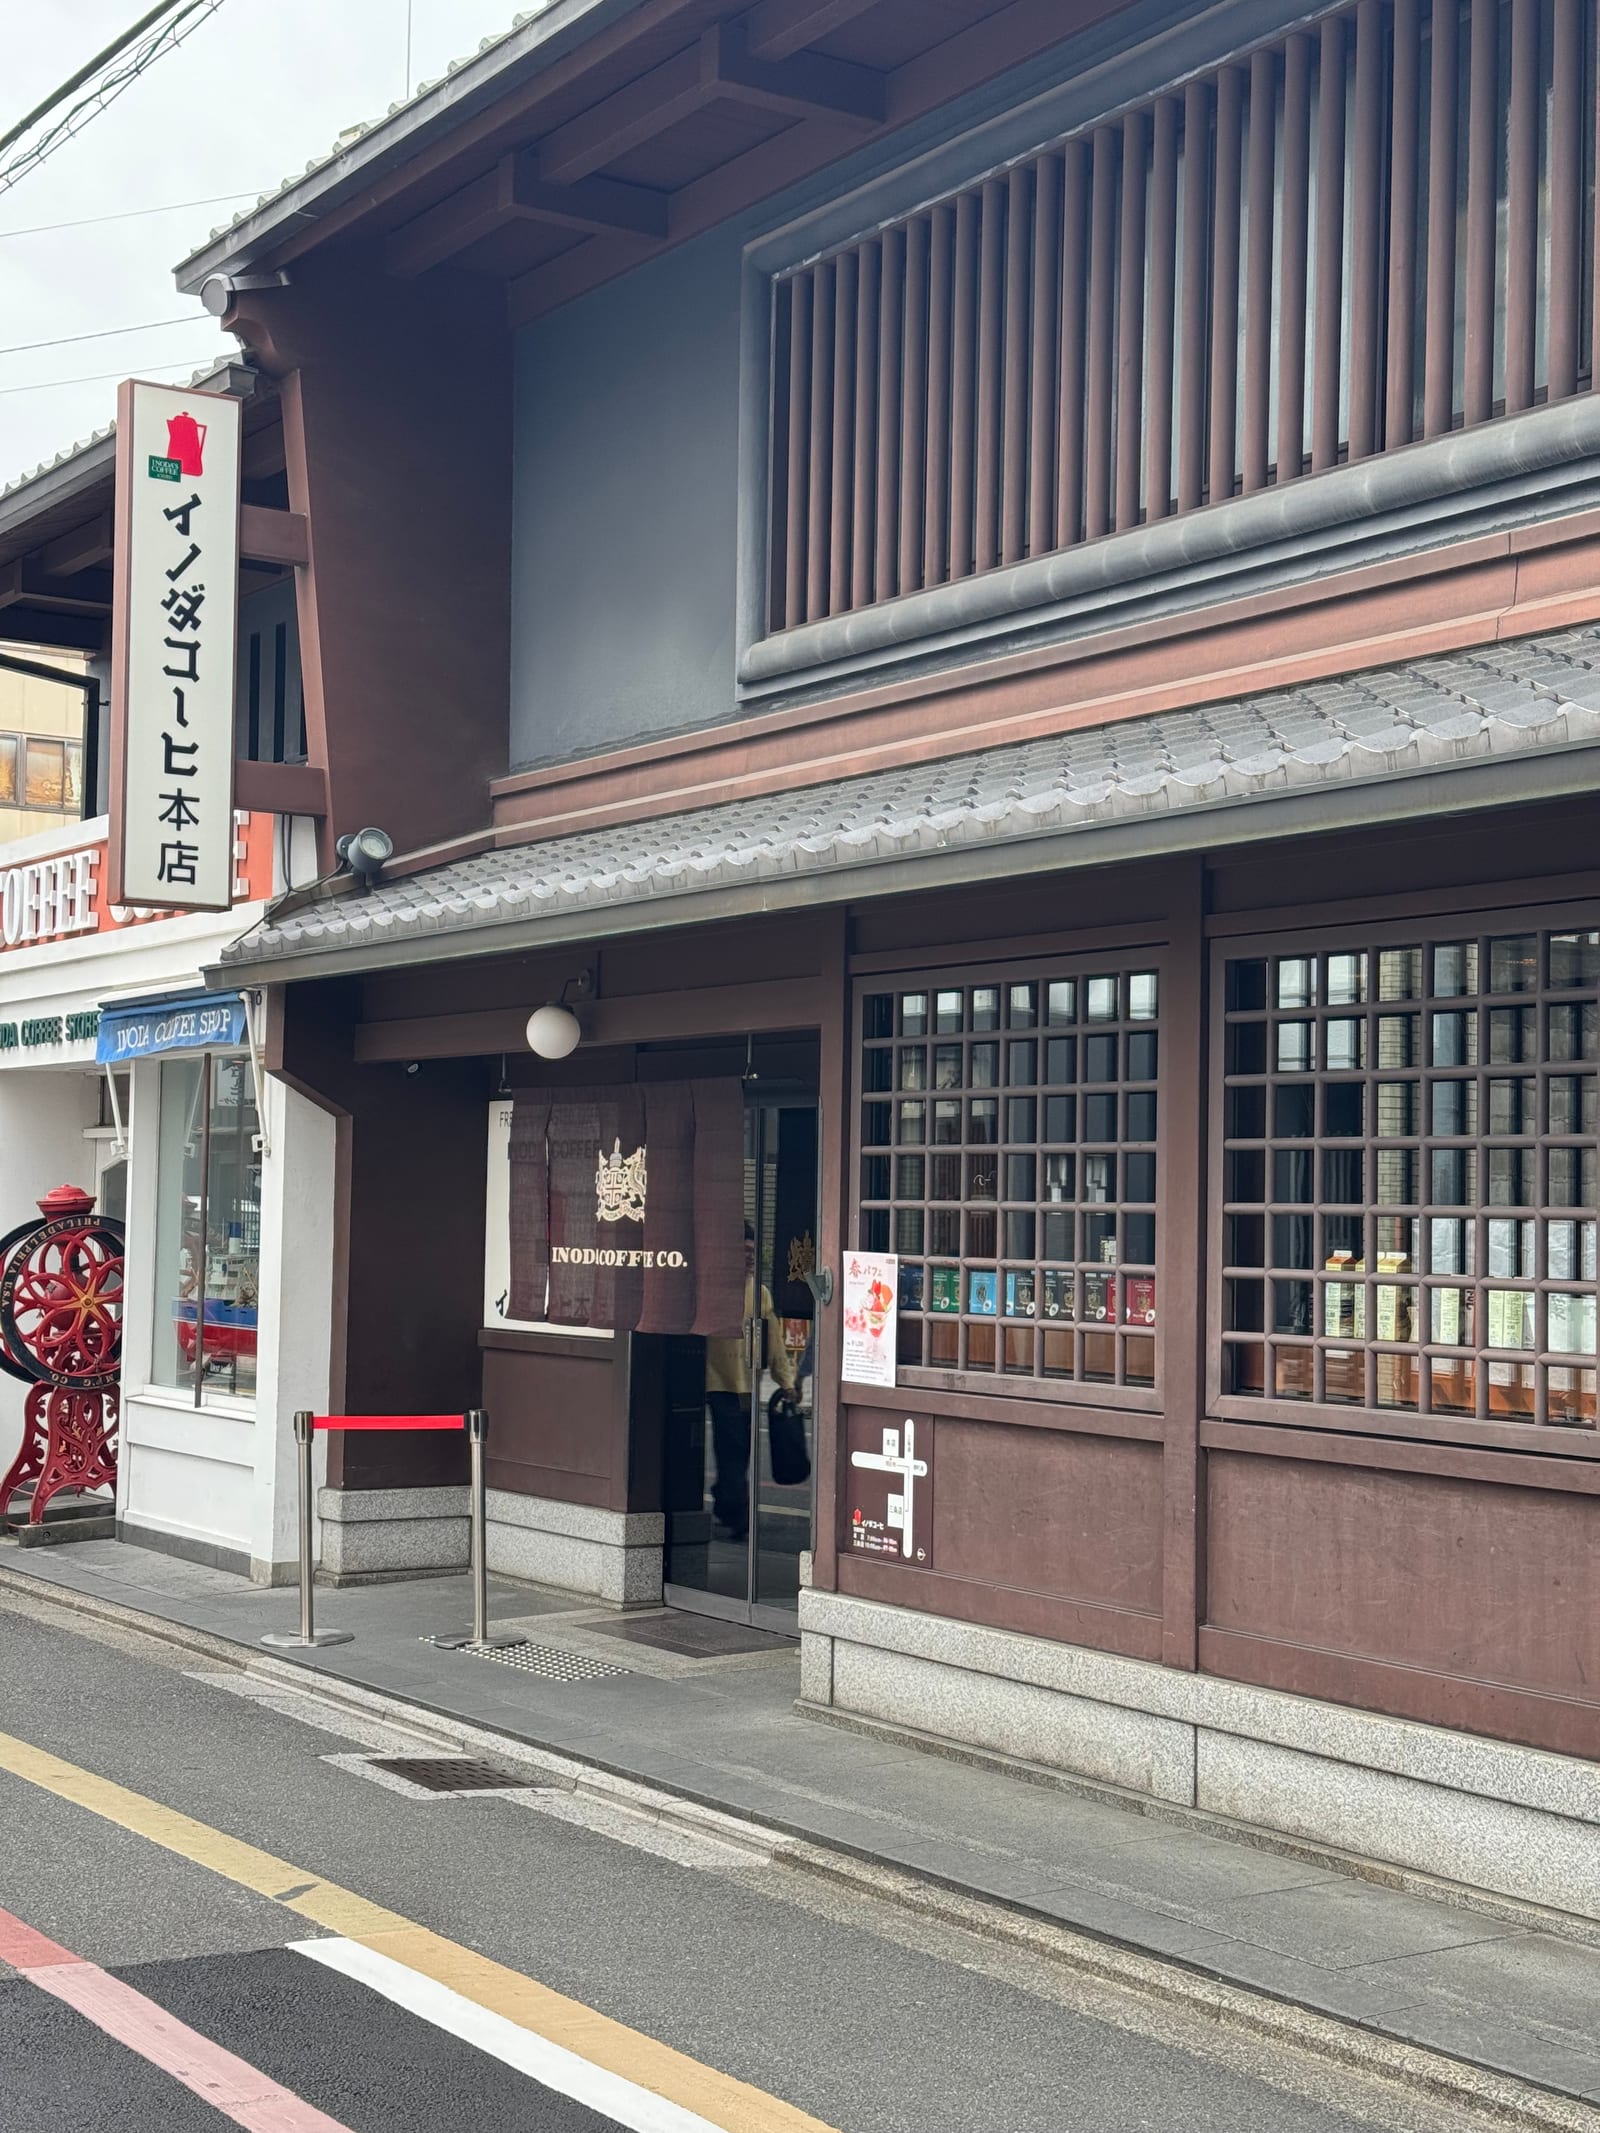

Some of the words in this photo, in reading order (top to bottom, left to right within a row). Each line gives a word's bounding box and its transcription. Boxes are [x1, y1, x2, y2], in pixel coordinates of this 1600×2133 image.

[151, 465, 178, 477] COFFEE
[157, 492, 206, 885] イノダコーヒ本店
[0, 848, 100, 947] OFFEE
[0, 1022, 18, 1049] DA
[21, 1016, 63, 1047] COFFEE
[8, 1217, 101, 1275] PHILADELPHIA
[656, 1250, 688, 1268] CO.
